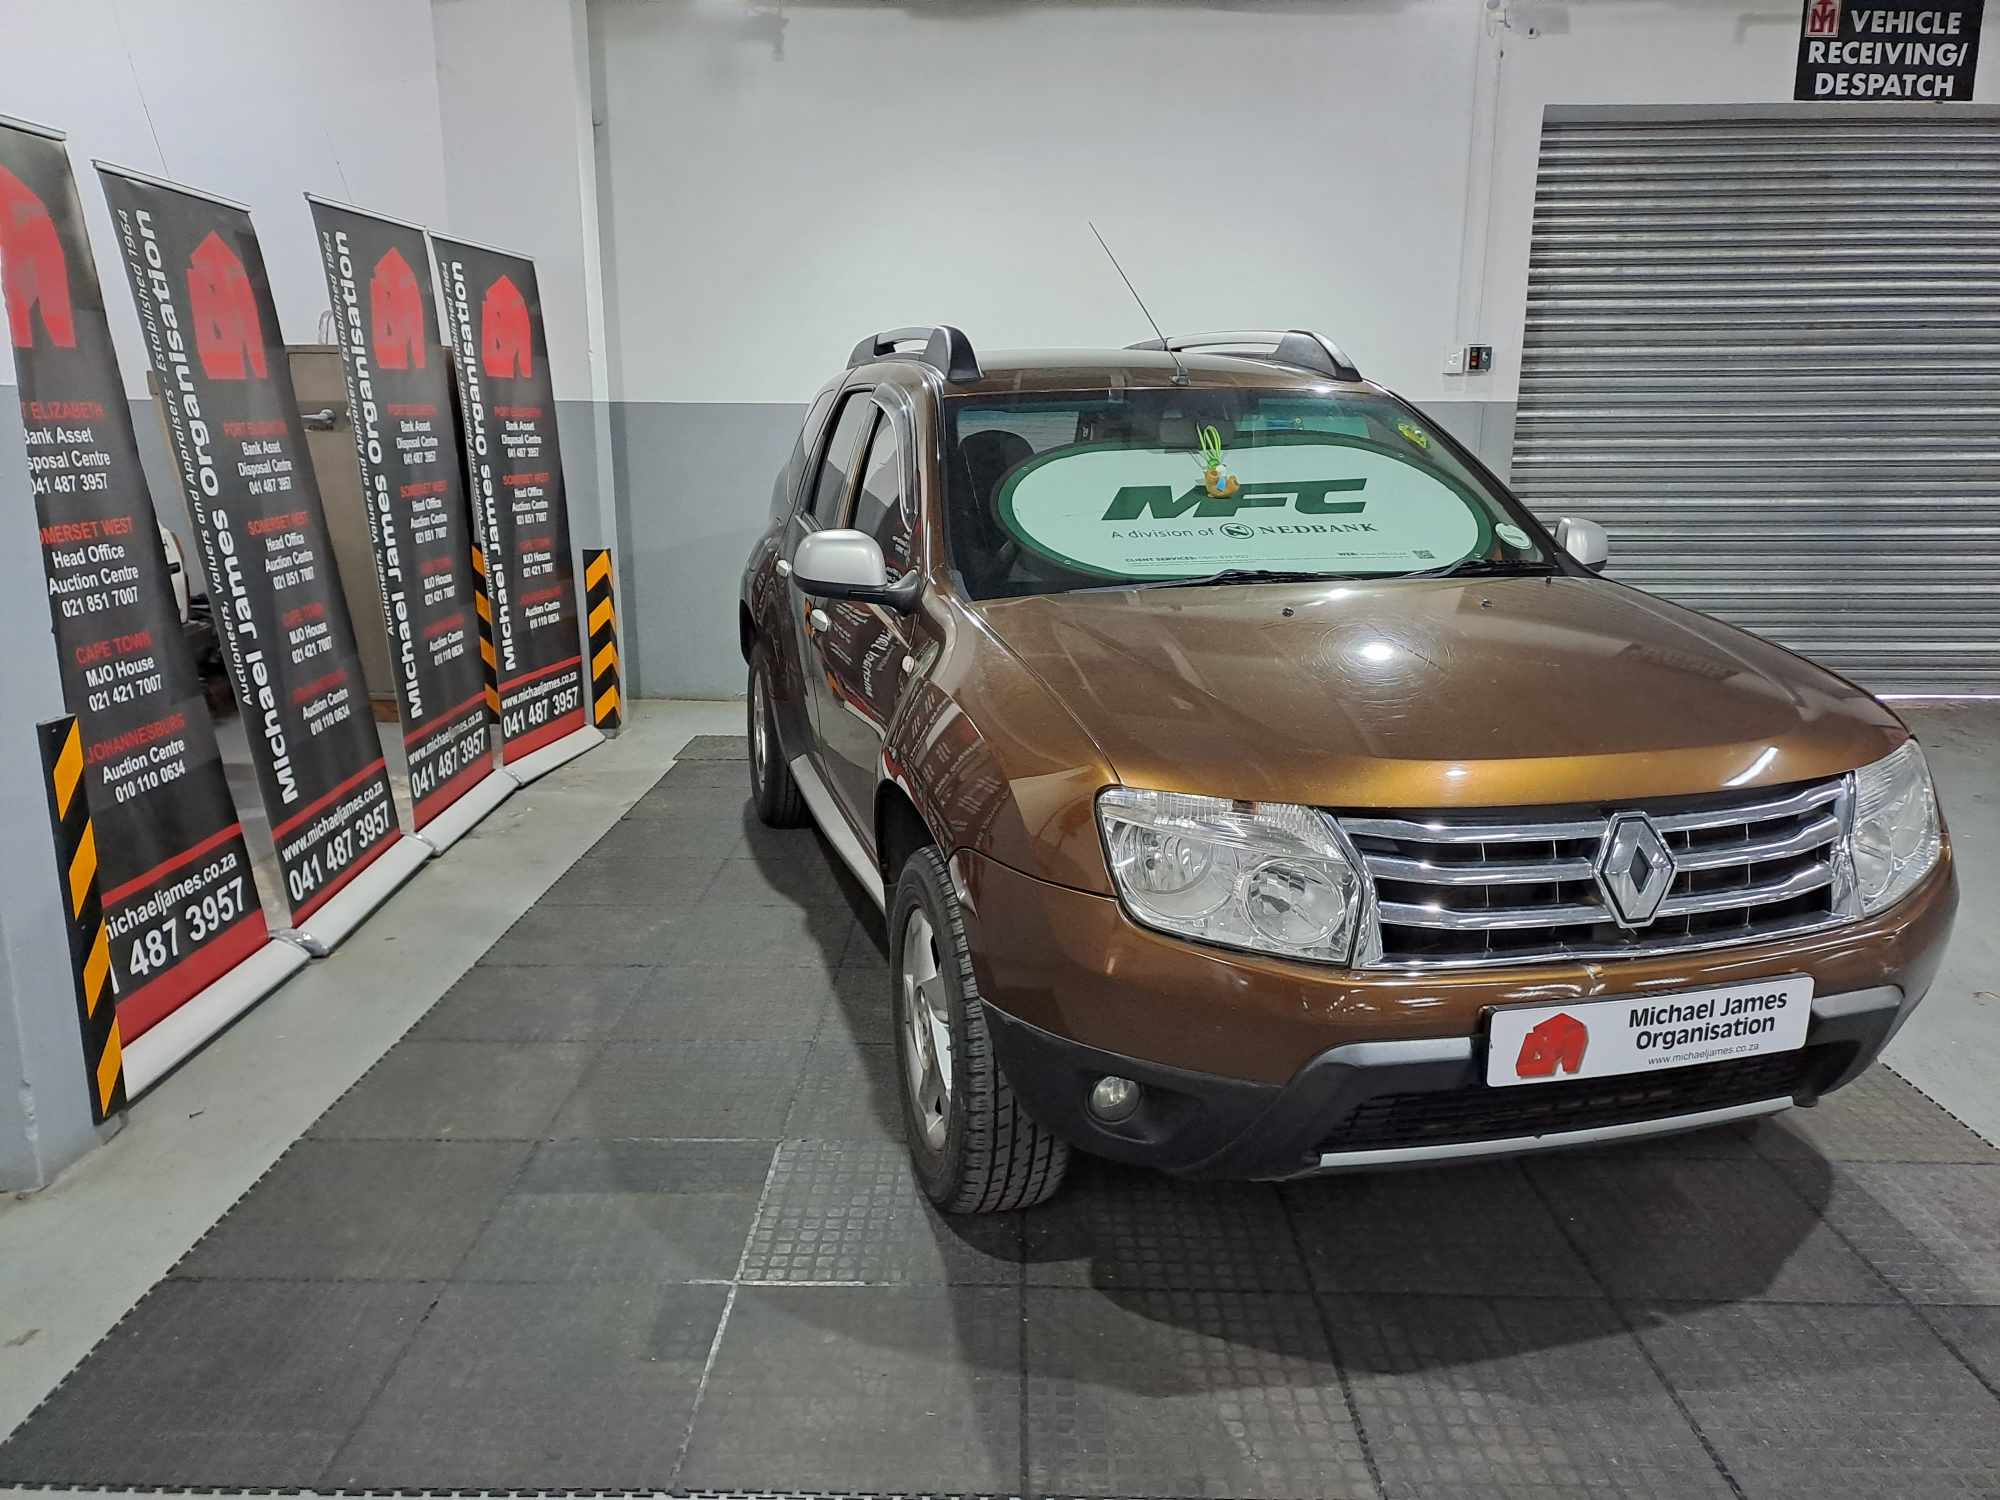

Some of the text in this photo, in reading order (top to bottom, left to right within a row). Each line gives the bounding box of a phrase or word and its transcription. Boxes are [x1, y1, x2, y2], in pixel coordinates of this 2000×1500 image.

[1851, 10, 1962, 34] VEHICLE
[1808, 41, 1968, 66] RECEIVING/
[1815, 72, 1954, 97] DESPATCH
[330, 274, 350, 362] Established
[347, 375, 365, 455] Appraisers
[56, 427, 94, 444] Asset
[242, 441, 262, 456] Bank
[27, 450, 111, 473] sposal Centre
[117, 208, 253, 705] Auctioneers, Valuers and Appraisers Established 1964
[238, 462, 272, 478] Disposal
[359, 458, 370, 485] and
[451, 261, 516, 671] Michael James Organisation
[54, 474, 76, 492] 487
[81, 473, 108, 492] 3957
[249, 482, 263, 495] 041
[335, 231, 423, 719] Michael James Organisation
[136, 209, 298, 805] Michael James Organisation
[1100, 478, 1367, 521] MFC
[99, 516, 132, 536] WEST
[365, 490, 378, 543] Valuers
[1112, 523, 1379, 539] A division of NEDBANK
[52, 544, 125, 568] Head Office
[266, 537, 284, 552] Head
[49, 564, 138, 595] Auction Centre
[265, 555, 292, 573] Auction
[62, 586, 138, 617] 021 851 7007
[304, 622, 328, 638] House
[75, 639, 112, 664] CAPE
[86, 656, 154, 687] MJO House
[88, 674, 162, 712] 021 421 7007
[302, 700, 328, 720] Auction
[503, 686, 578, 738] 041 487 3957
[103, 738, 185, 784] Auction Centre
[412, 728, 484, 798] 041 487 3957
[115, 760, 186, 803] 010 110 0634
[282, 780, 384, 862] www.michaeljames.co.za
[289, 800, 390, 901] 041 487 3957
[105, 852, 238, 942] michaeljames.co.za
[129, 917, 180, 977] 487
[185, 876, 244, 941] 3957
[1630, 992, 1788, 1028] Michael James
[1636, 1014, 1775, 1050] Organisation
[1648, 1043, 1760, 1064] www.michaeljames.co.za
